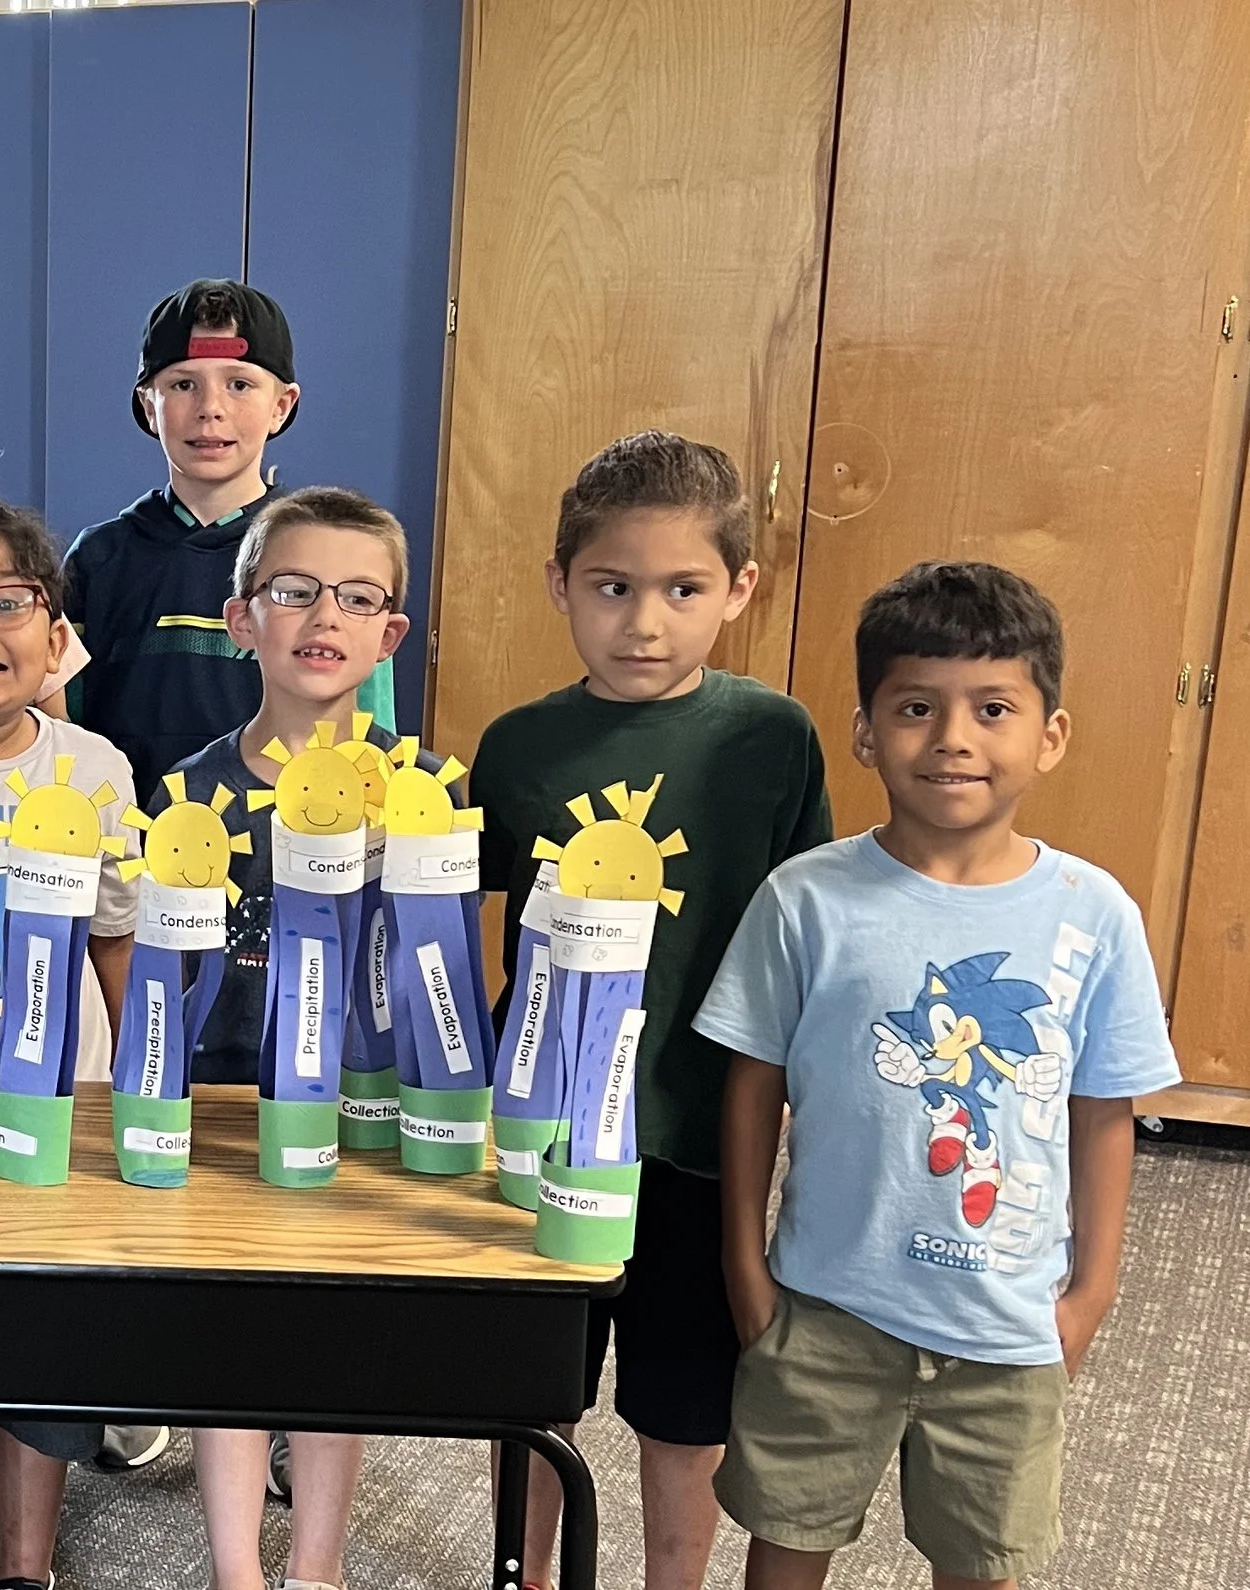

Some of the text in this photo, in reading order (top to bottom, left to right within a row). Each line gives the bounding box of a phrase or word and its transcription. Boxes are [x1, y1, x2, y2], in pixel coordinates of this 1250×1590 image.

[25, 959, 46, 1042] Evaporation
[303, 957, 322, 1054] Precipitation
[374, 924, 386, 1009] Evaporation
[430, 965, 462, 1051] Evaporation
[142, 1000, 163, 1096] Precipitation
[517, 972, 548, 1067] Evaporation
[603, 1034, 634, 1133] Evaporation
[912, 1232, 986, 1260] SONIC
